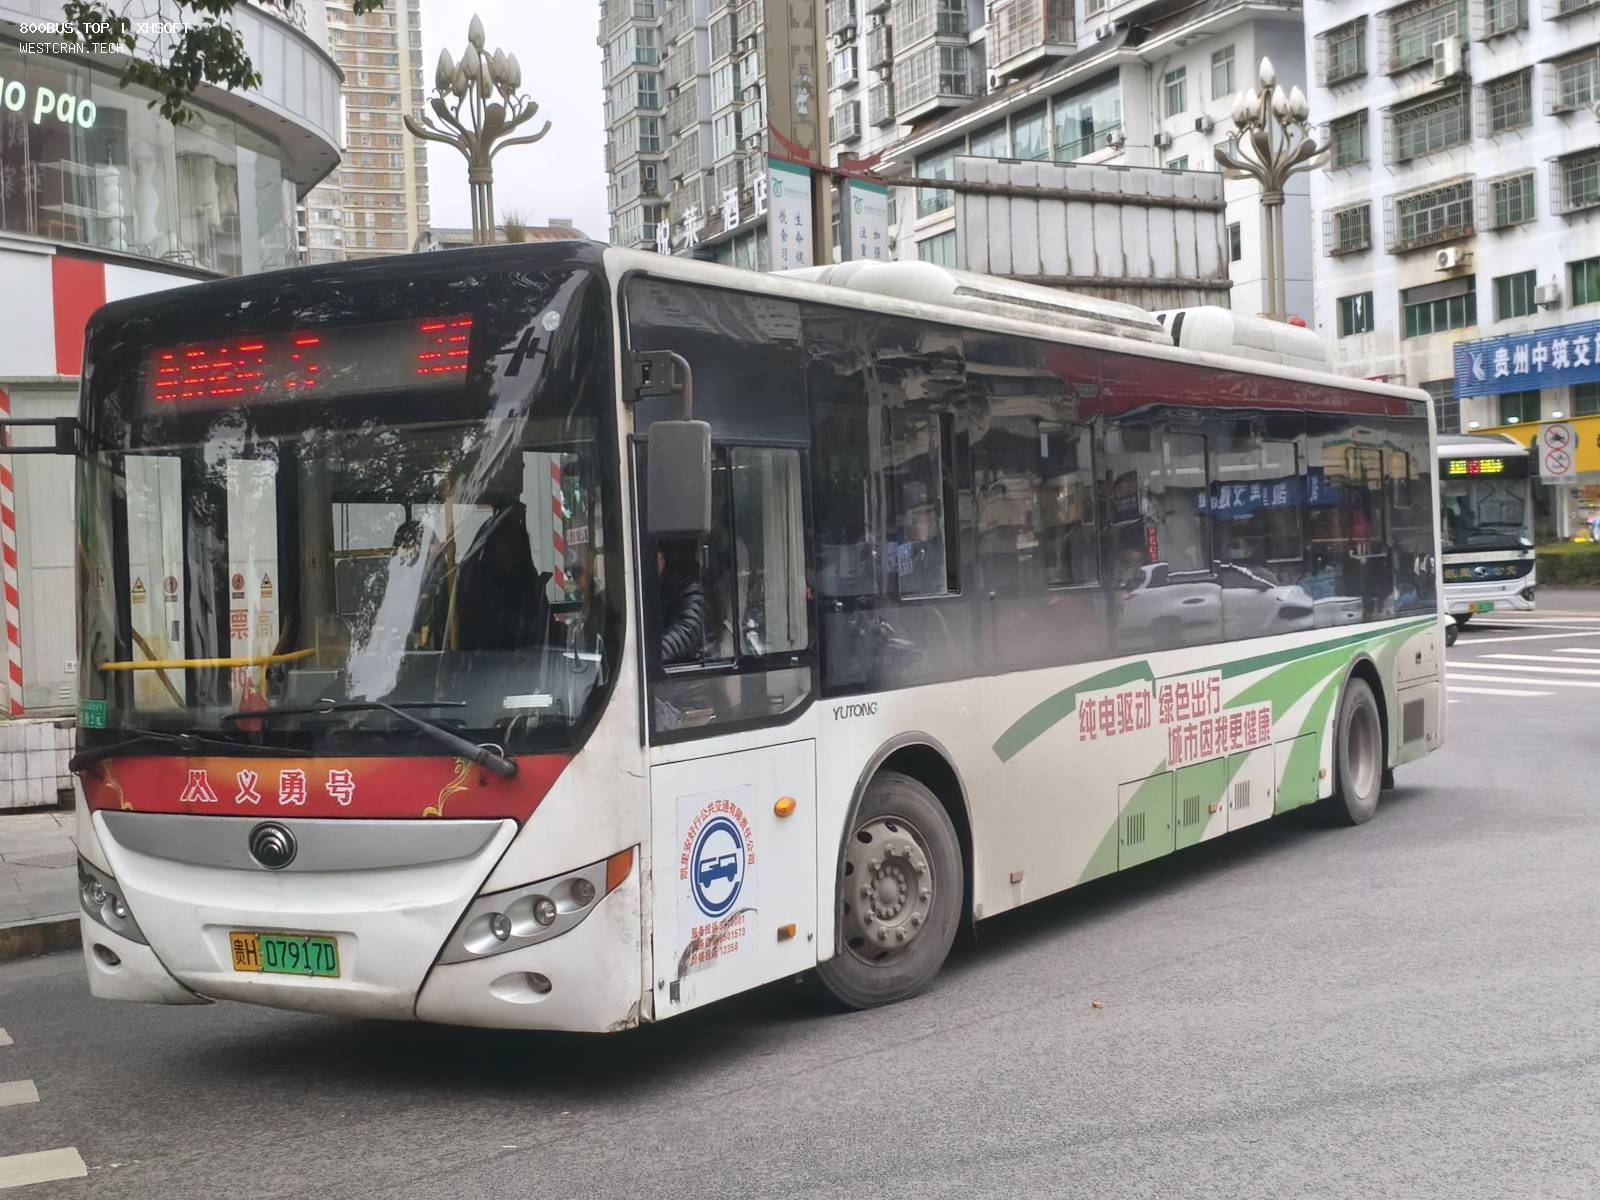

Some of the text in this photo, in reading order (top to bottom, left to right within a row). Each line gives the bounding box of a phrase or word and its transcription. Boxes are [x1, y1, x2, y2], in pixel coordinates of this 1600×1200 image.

[0, 76, 97, 129] o pao
[832, 701, 879, 721] YUTONG
[1079, 676, 1220, 742] 纯电驱动 绿色出行
[1167, 706, 1270, 766] 城市因我更健康
